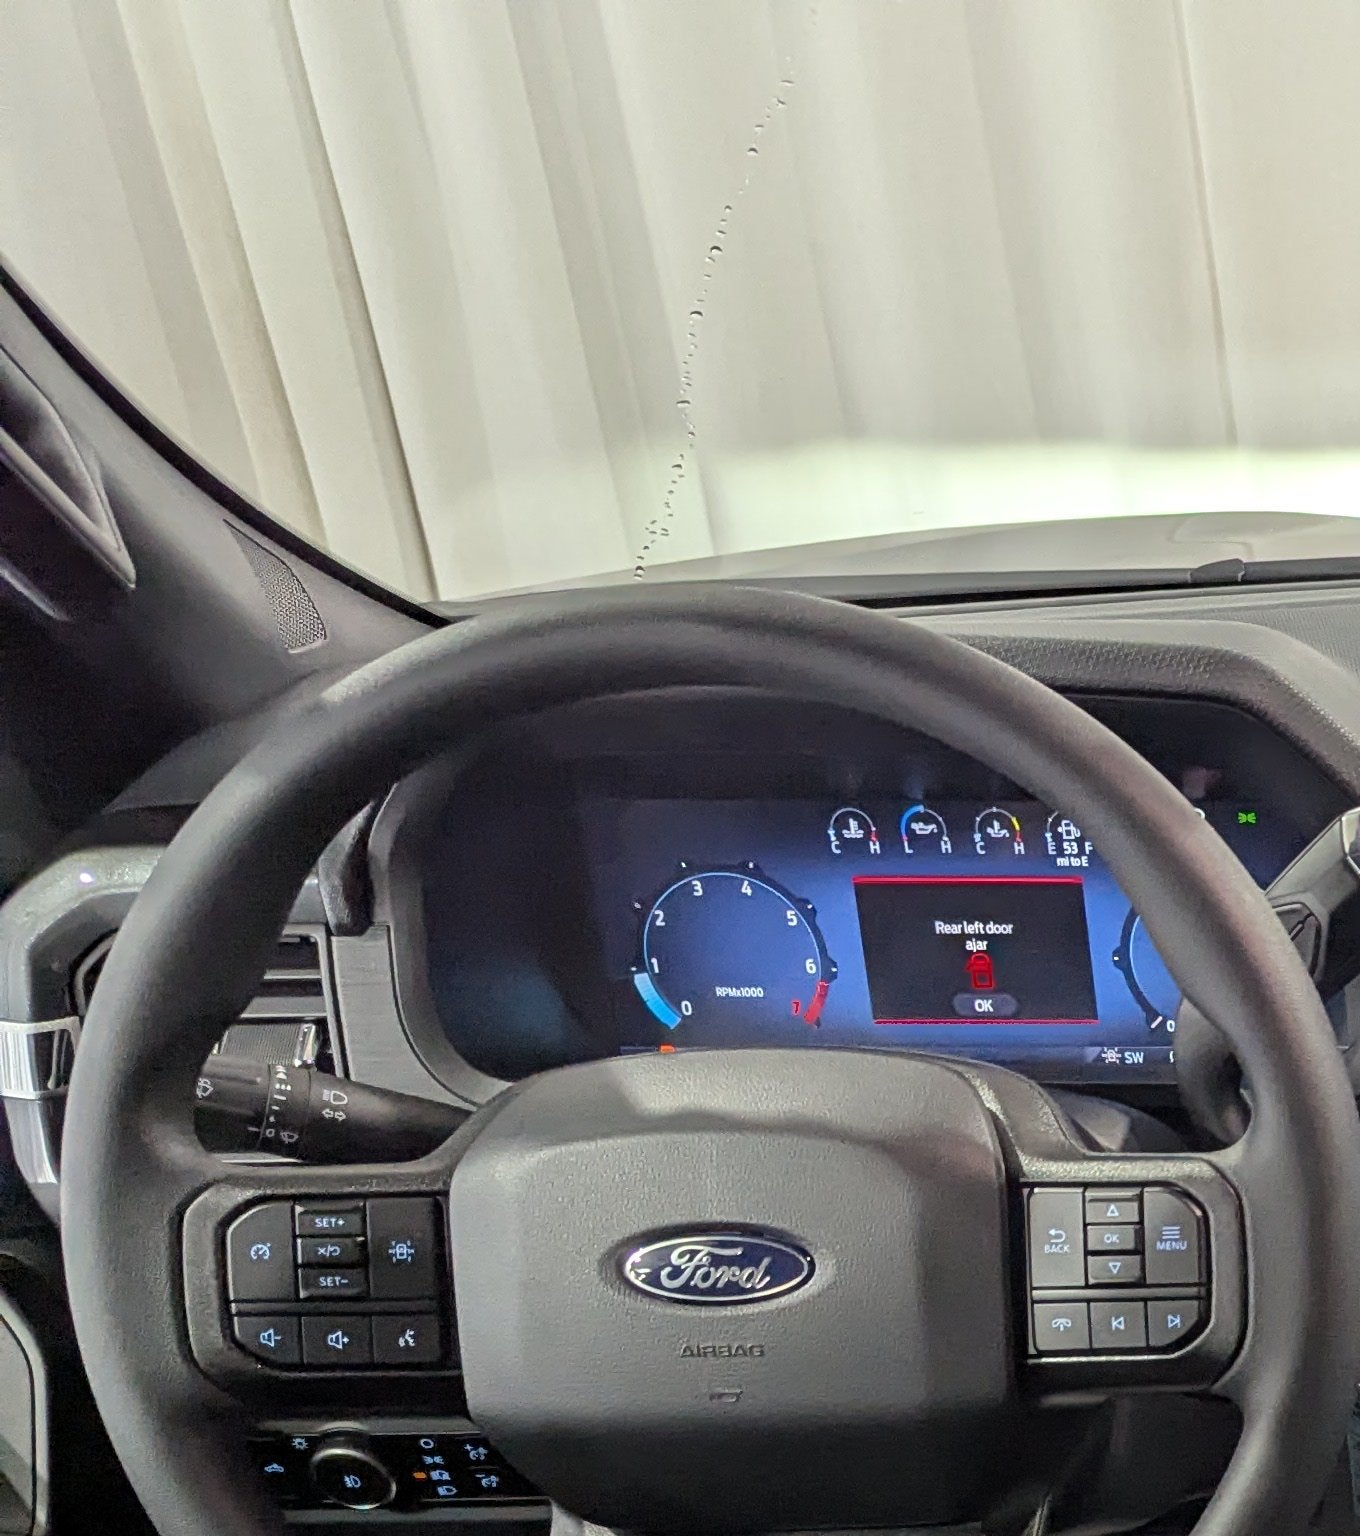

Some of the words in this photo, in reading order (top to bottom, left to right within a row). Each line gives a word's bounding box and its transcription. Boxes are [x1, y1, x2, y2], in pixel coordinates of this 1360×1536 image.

[831, 841, 841, 855] C
[869, 841, 881, 855] H
[904, 841, 914, 855] L
[941, 841, 952, 855] H
[976, 841, 986, 855] C
[1014, 841, 1026, 855] H
[1047, 841, 1057, 855] E
[1063, 841, 1079, 855] 53
[1056, 856, 1070, 867] mi
[1070, 856, 1081, 867] to
[1081, 856, 1089, 867] E
[692, 880, 703, 896] 3
[741, 880, 752, 896] 4
[654, 910, 666, 926] 2
[786, 910, 798, 926] 5
[934, 920, 963, 934] Rear
[962, 920, 985, 934] left
[985, 920, 1014, 934] door
[965, 937, 989, 953] ajar
[651, 957, 660, 974] 1
[805, 958, 817, 974] 6
[681, 1000, 693, 1016] 0
[791, 999, 801, 1015] 7
[974, 999, 994, 1012] OK
[1124, 1051, 1144, 1064] SW
[314, 1218, 346, 1228] SET+
[1103, 1234, 1120, 1244] OK
[1156, 1241, 1188, 1251] MENU
[1044, 1245, 1070, 1254] BACK
[660, 1244, 773, 1289] Ford
[680, 1344, 766, 1358] AIRBAG
